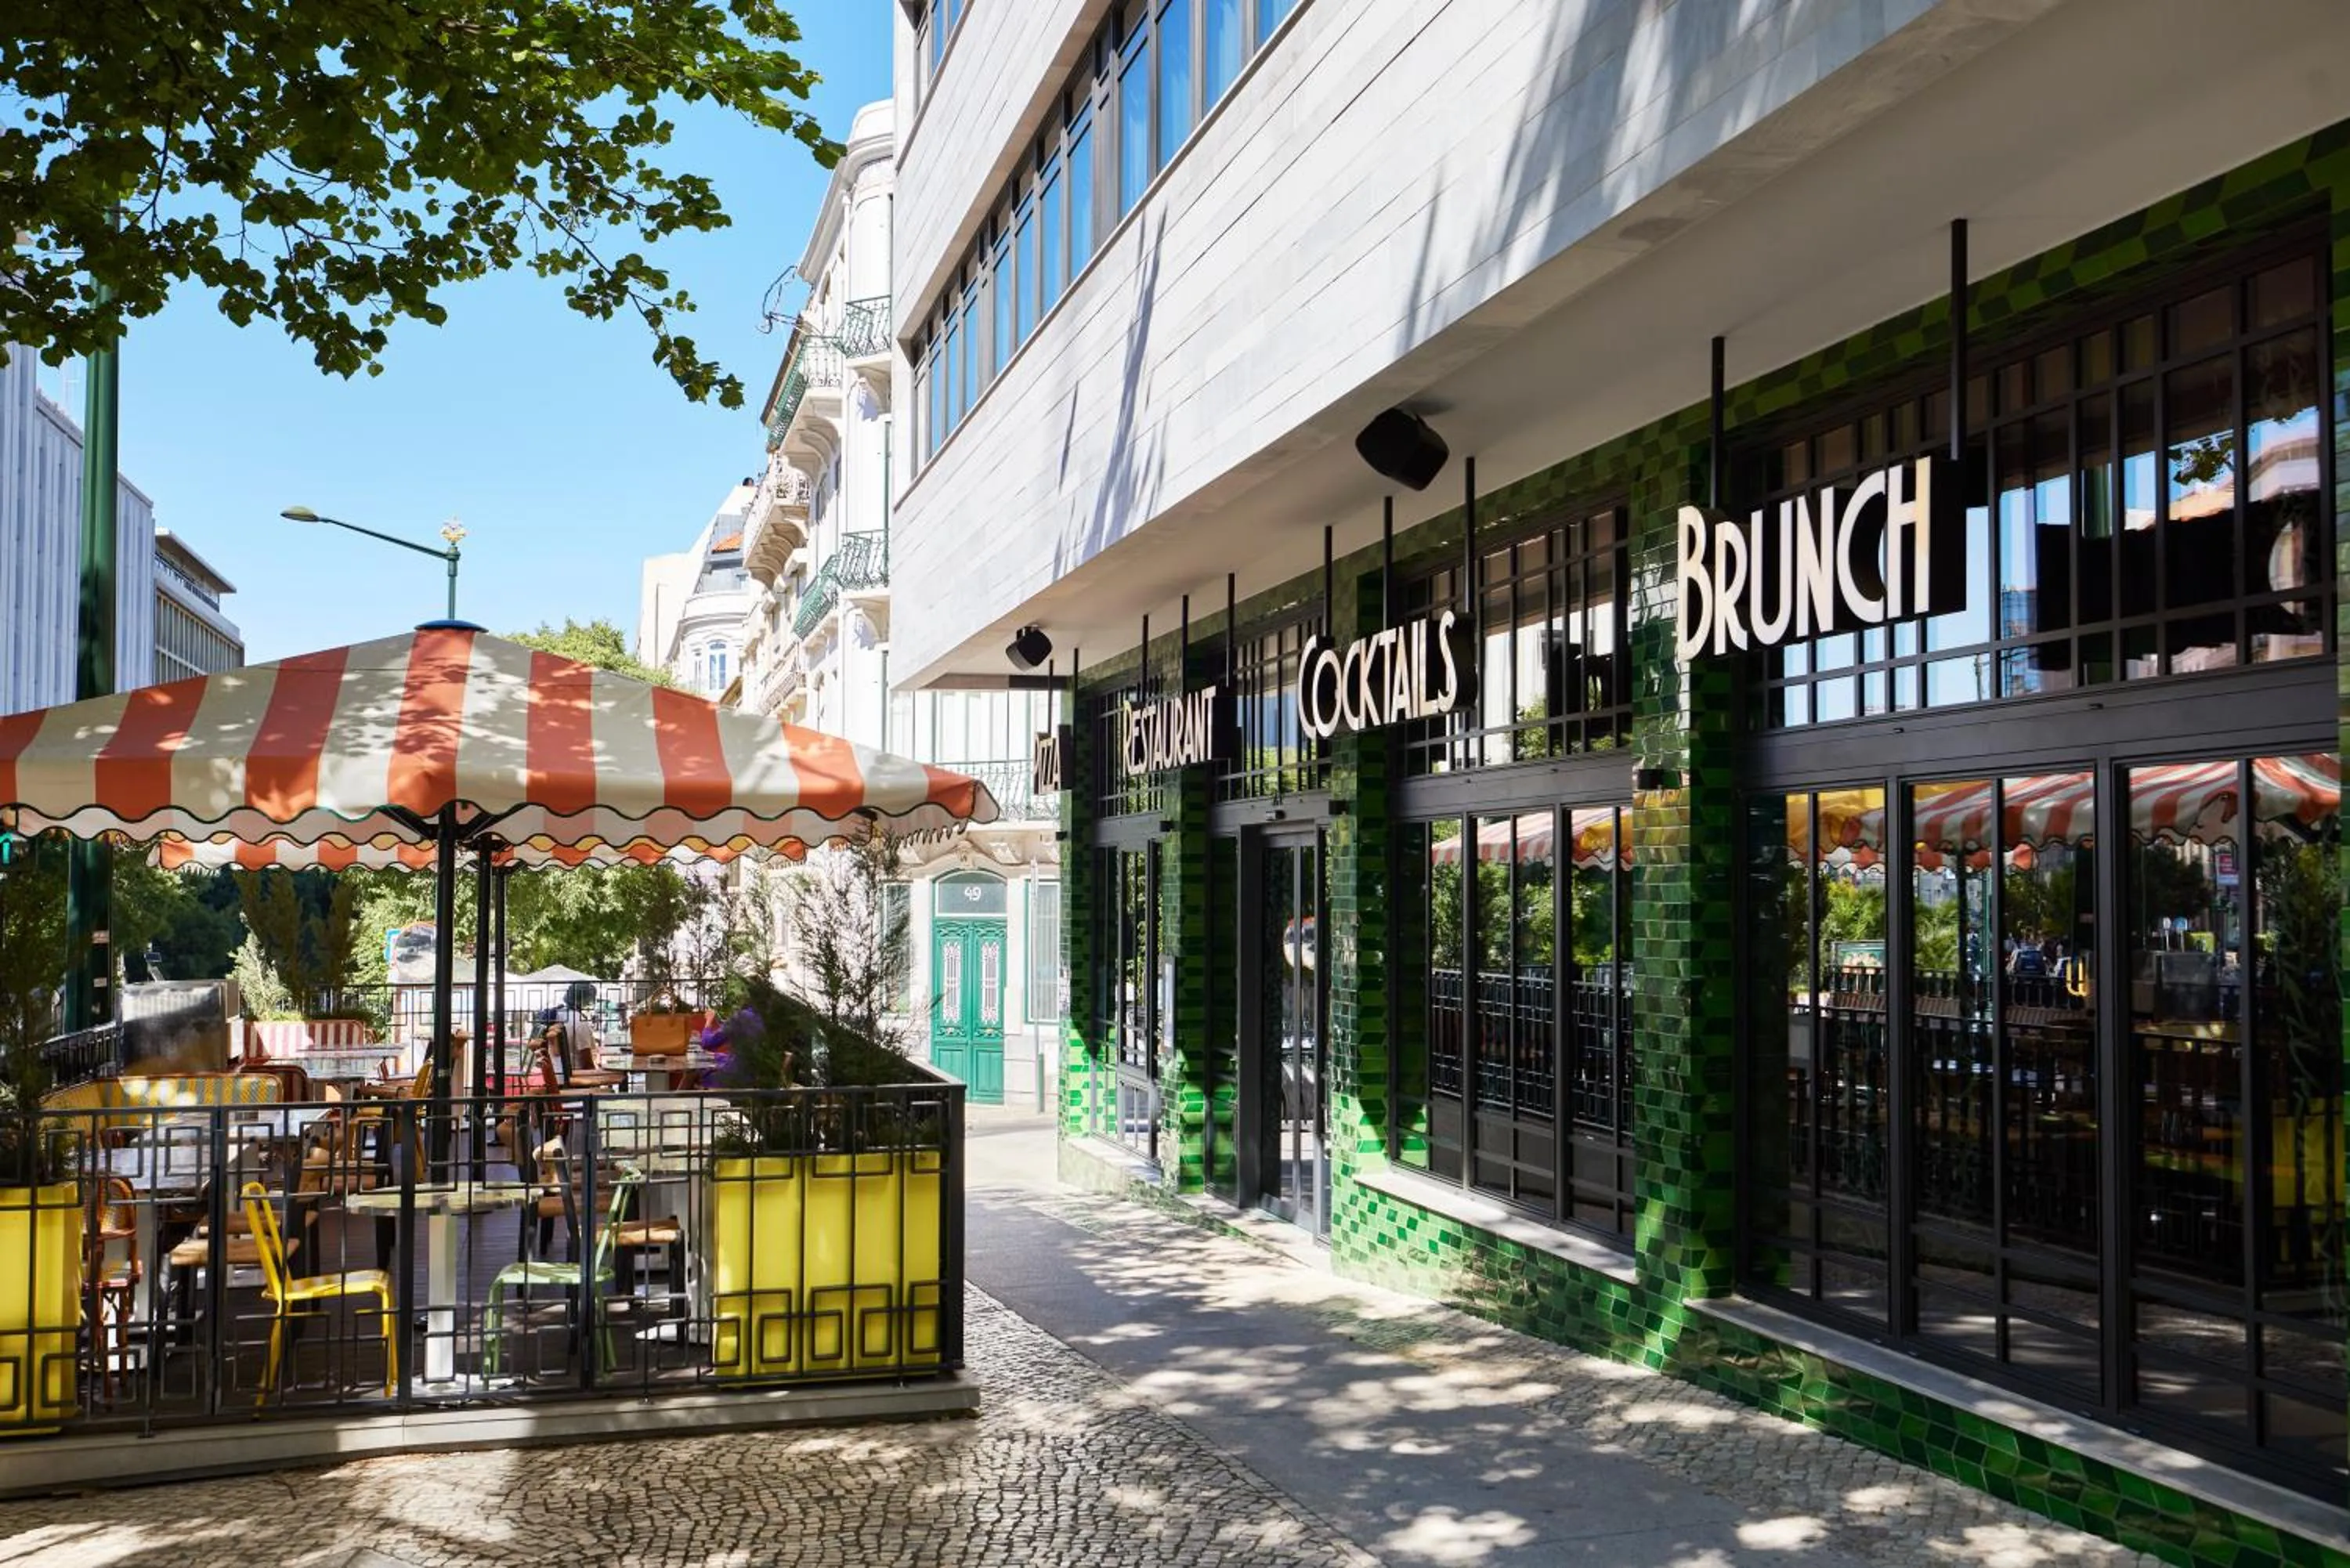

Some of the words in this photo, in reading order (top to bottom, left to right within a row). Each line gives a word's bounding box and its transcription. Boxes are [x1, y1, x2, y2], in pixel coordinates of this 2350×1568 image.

[1677, 456, 1931, 660] BRUNCH
[1298, 610, 1458, 739] COCKTAILS
[1032, 734, 1061, 796] PIZZA
[1123, 685, 1216, 778] RESTAURANT
[964, 886, 982, 901] 49
